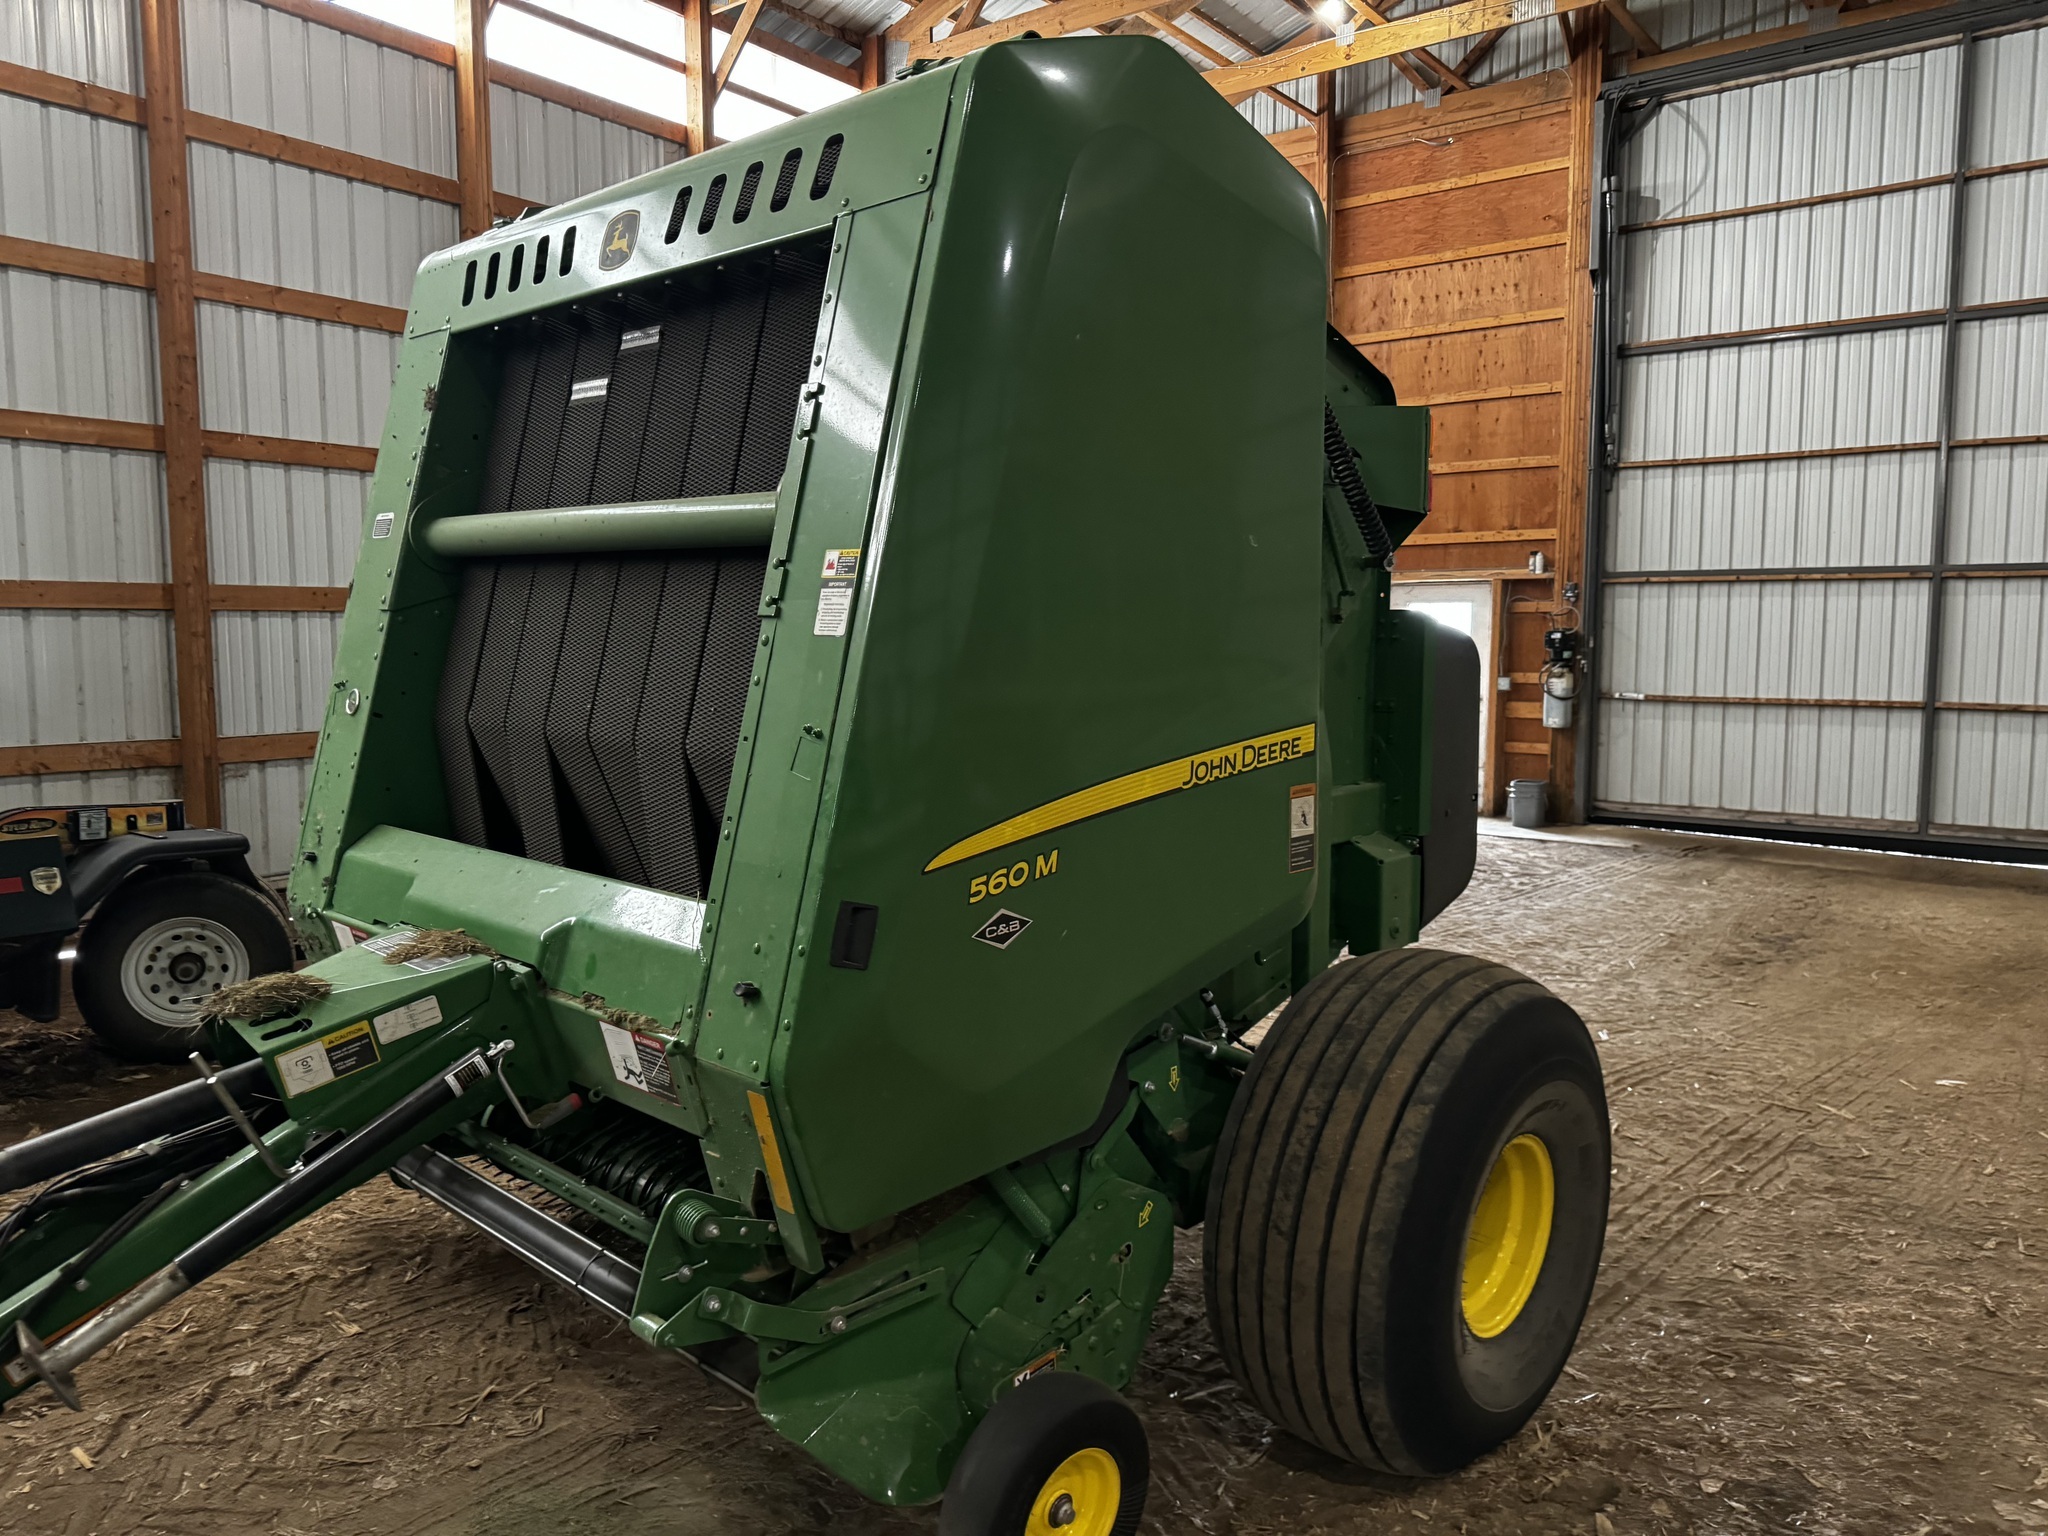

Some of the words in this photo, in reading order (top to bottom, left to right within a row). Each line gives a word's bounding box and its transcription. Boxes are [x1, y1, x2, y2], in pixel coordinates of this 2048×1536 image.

[1182, 753, 1237, 786] JOHN
[1241, 736, 1301, 769] DEERE
[969, 861, 1030, 904] 560
[1035, 849, 1059, 880] M
[985, 920, 1020, 938] C&B
[334, 1028, 364, 1042] CAUTION
[640, 1036, 661, 1049] DANGER
